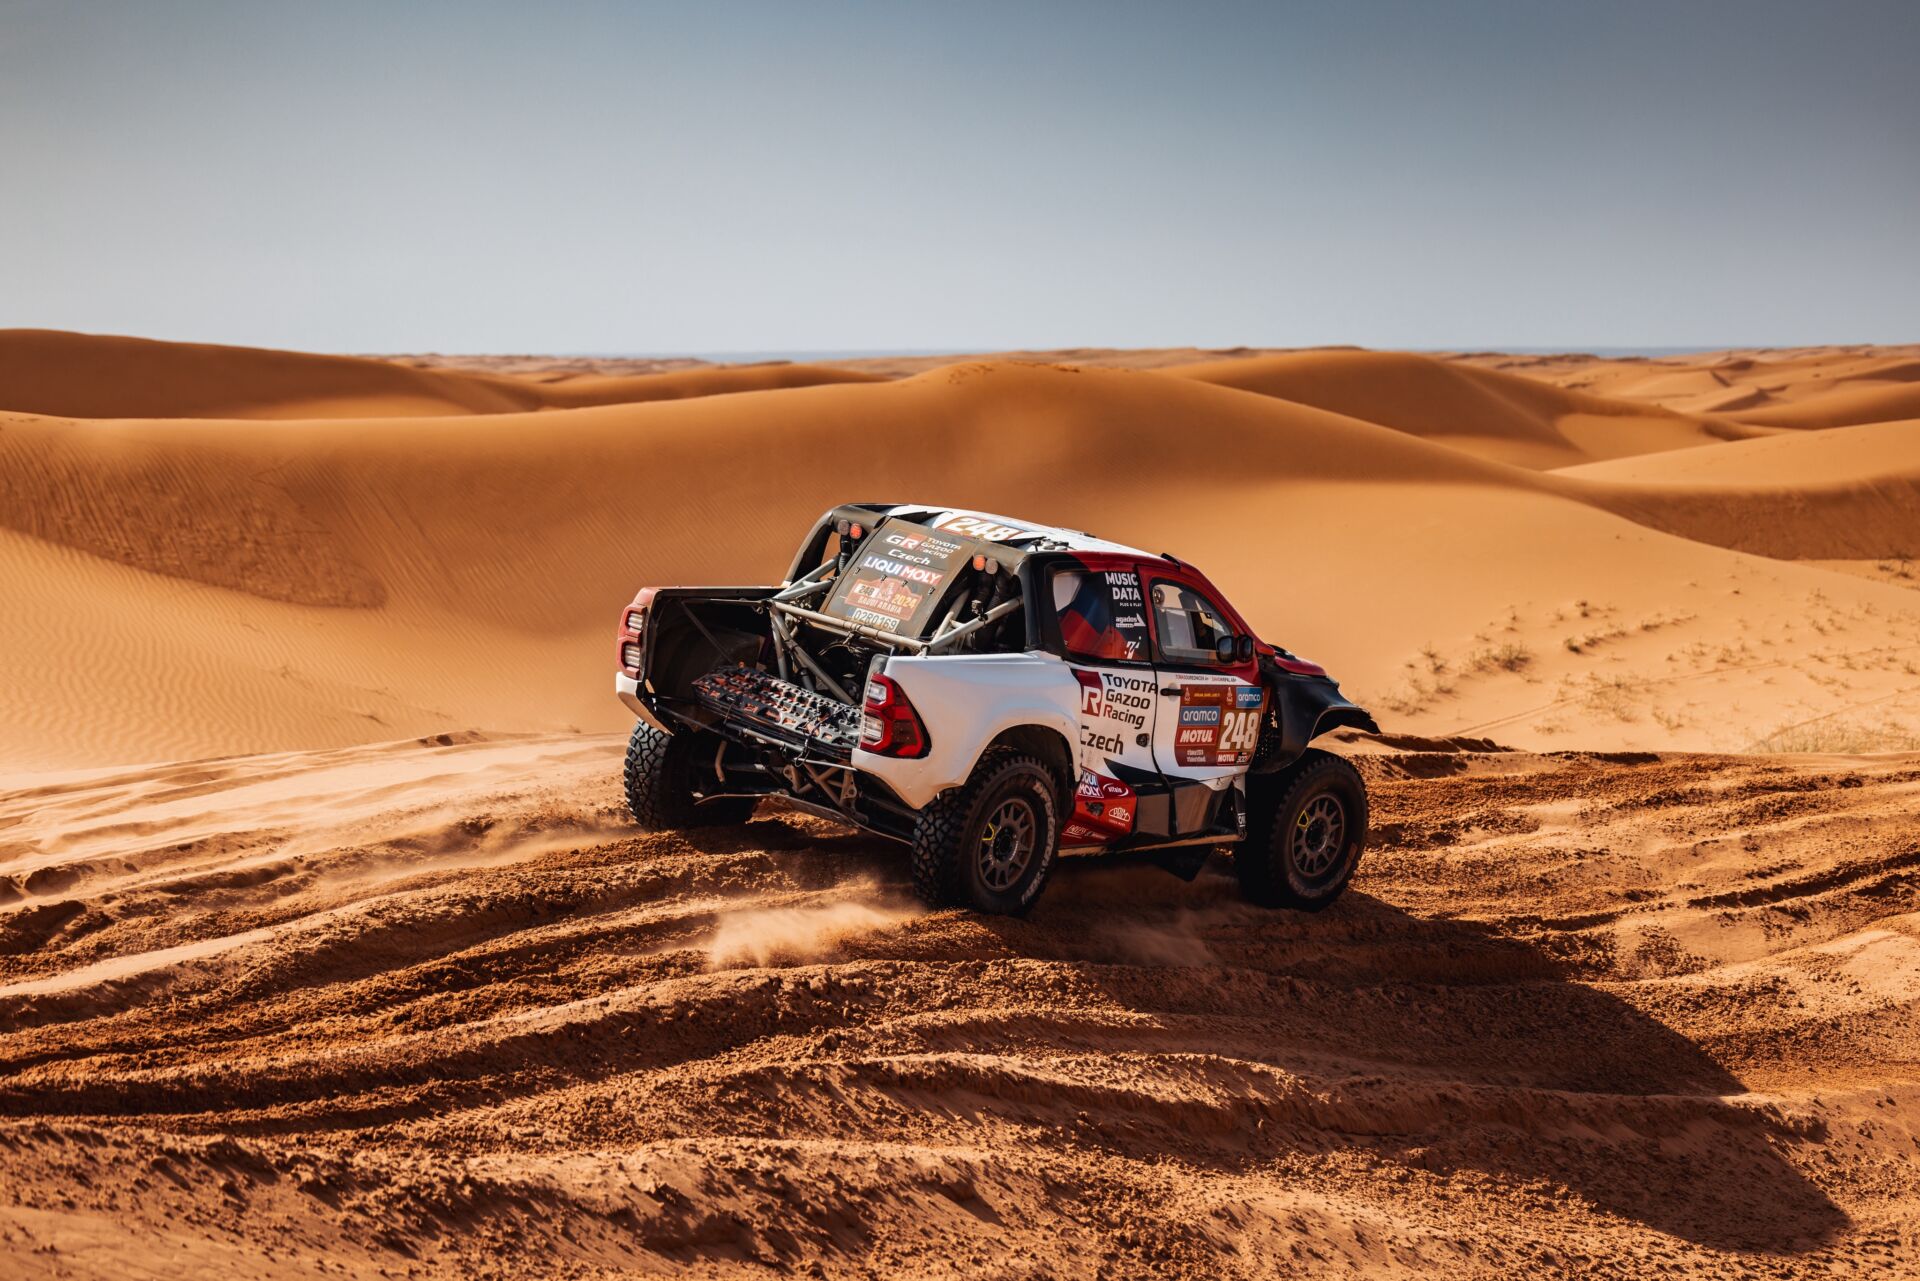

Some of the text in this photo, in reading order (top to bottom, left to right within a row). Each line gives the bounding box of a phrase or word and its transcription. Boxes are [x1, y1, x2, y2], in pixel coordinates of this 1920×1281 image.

[942, 517, 1021, 541] 248
[886, 534, 918, 550] GR
[920, 542, 954, 554] GAZOO
[927, 537, 962, 550] TOYOTA
[887, 548, 931, 565] Czech
[916, 546, 949, 560] Racing
[863, 556, 941, 583] LIQUI MOLY
[1105, 572, 1139, 586] MUSIC
[891, 593, 918, 609] 2024
[1112, 587, 1141, 601] DATA
[1102, 673, 1158, 694] TOYOTA
[1105, 689, 1151, 709] GAZOO
[1238, 692, 1261, 702] aramco
[1103, 704, 1145, 729] Racing
[1183, 710, 1218, 722] aramco
[1180, 729, 1213, 743] MOTUL
[1219, 711, 1260, 750] 248
[1217, 753, 1235, 762] MOTUL
